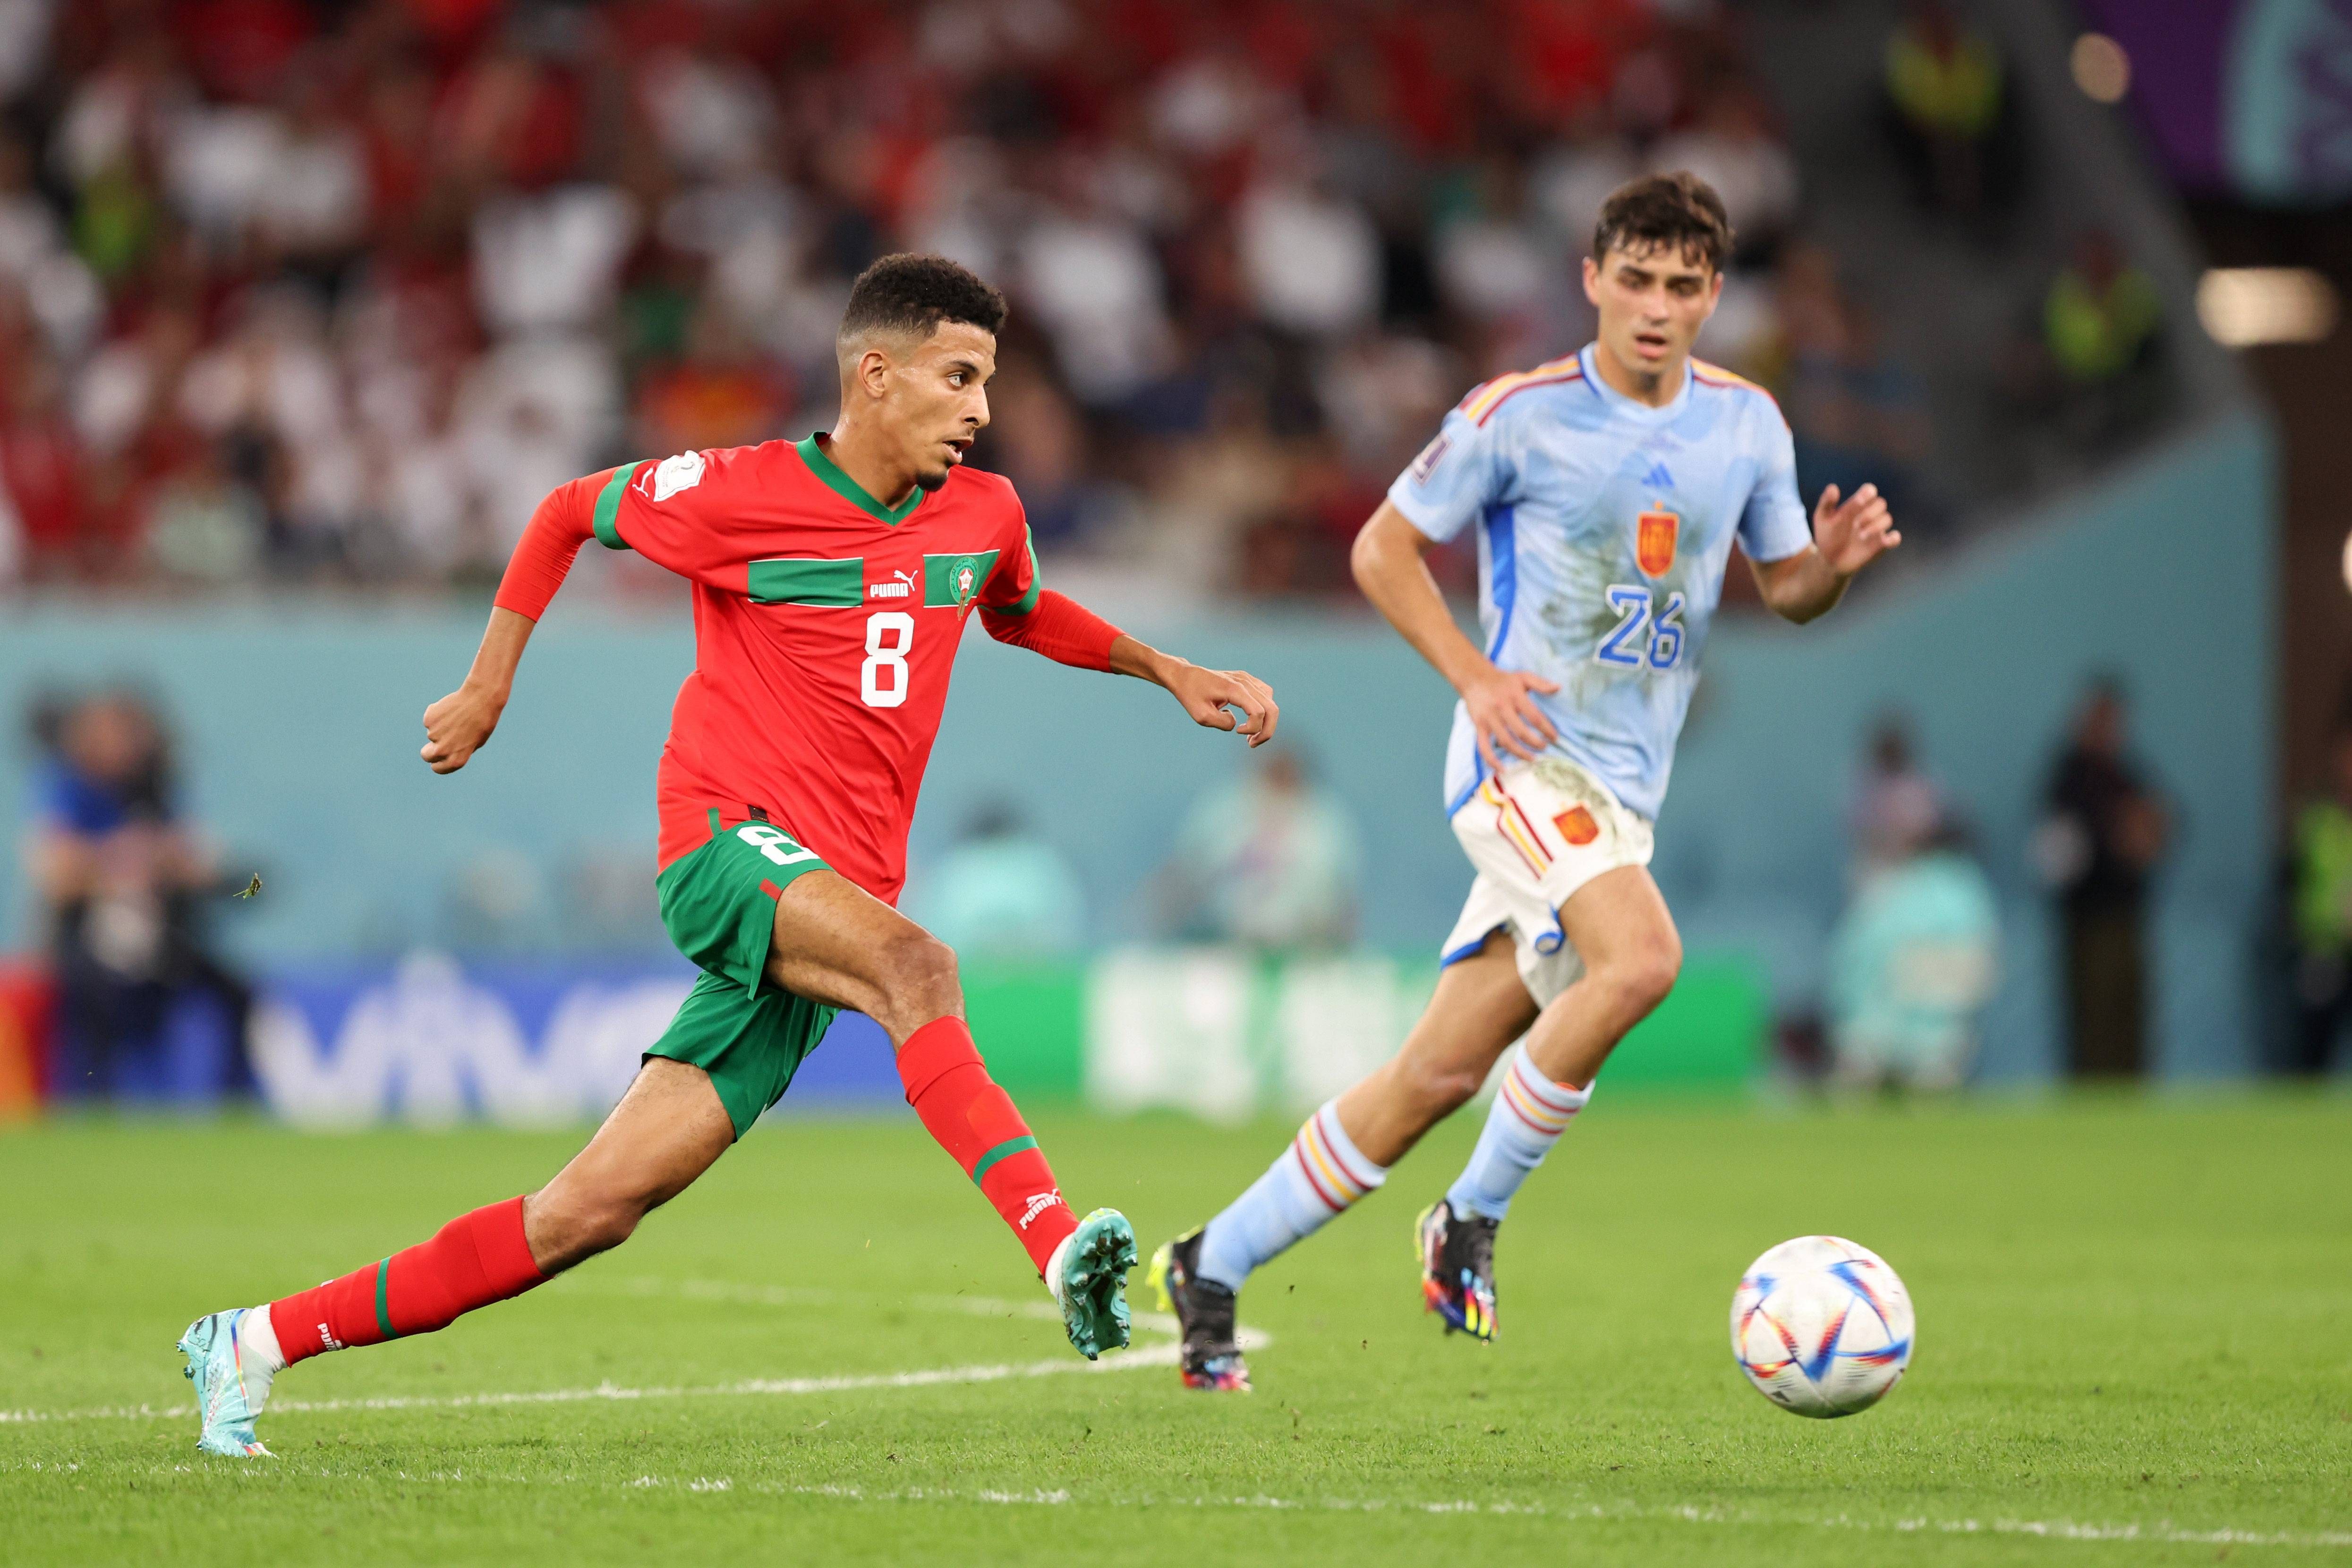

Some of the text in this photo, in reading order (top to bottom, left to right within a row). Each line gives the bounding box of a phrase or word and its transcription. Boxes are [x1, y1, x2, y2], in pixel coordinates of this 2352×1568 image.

[870, 583, 909, 597] PUMA
[1593, 584, 1685, 671] 26
[861, 612, 914, 707] 8
[736, 826, 821, 866] 8
[1019, 1196, 1057, 1230] PUMA
[317, 1322, 338, 1351] PUM
